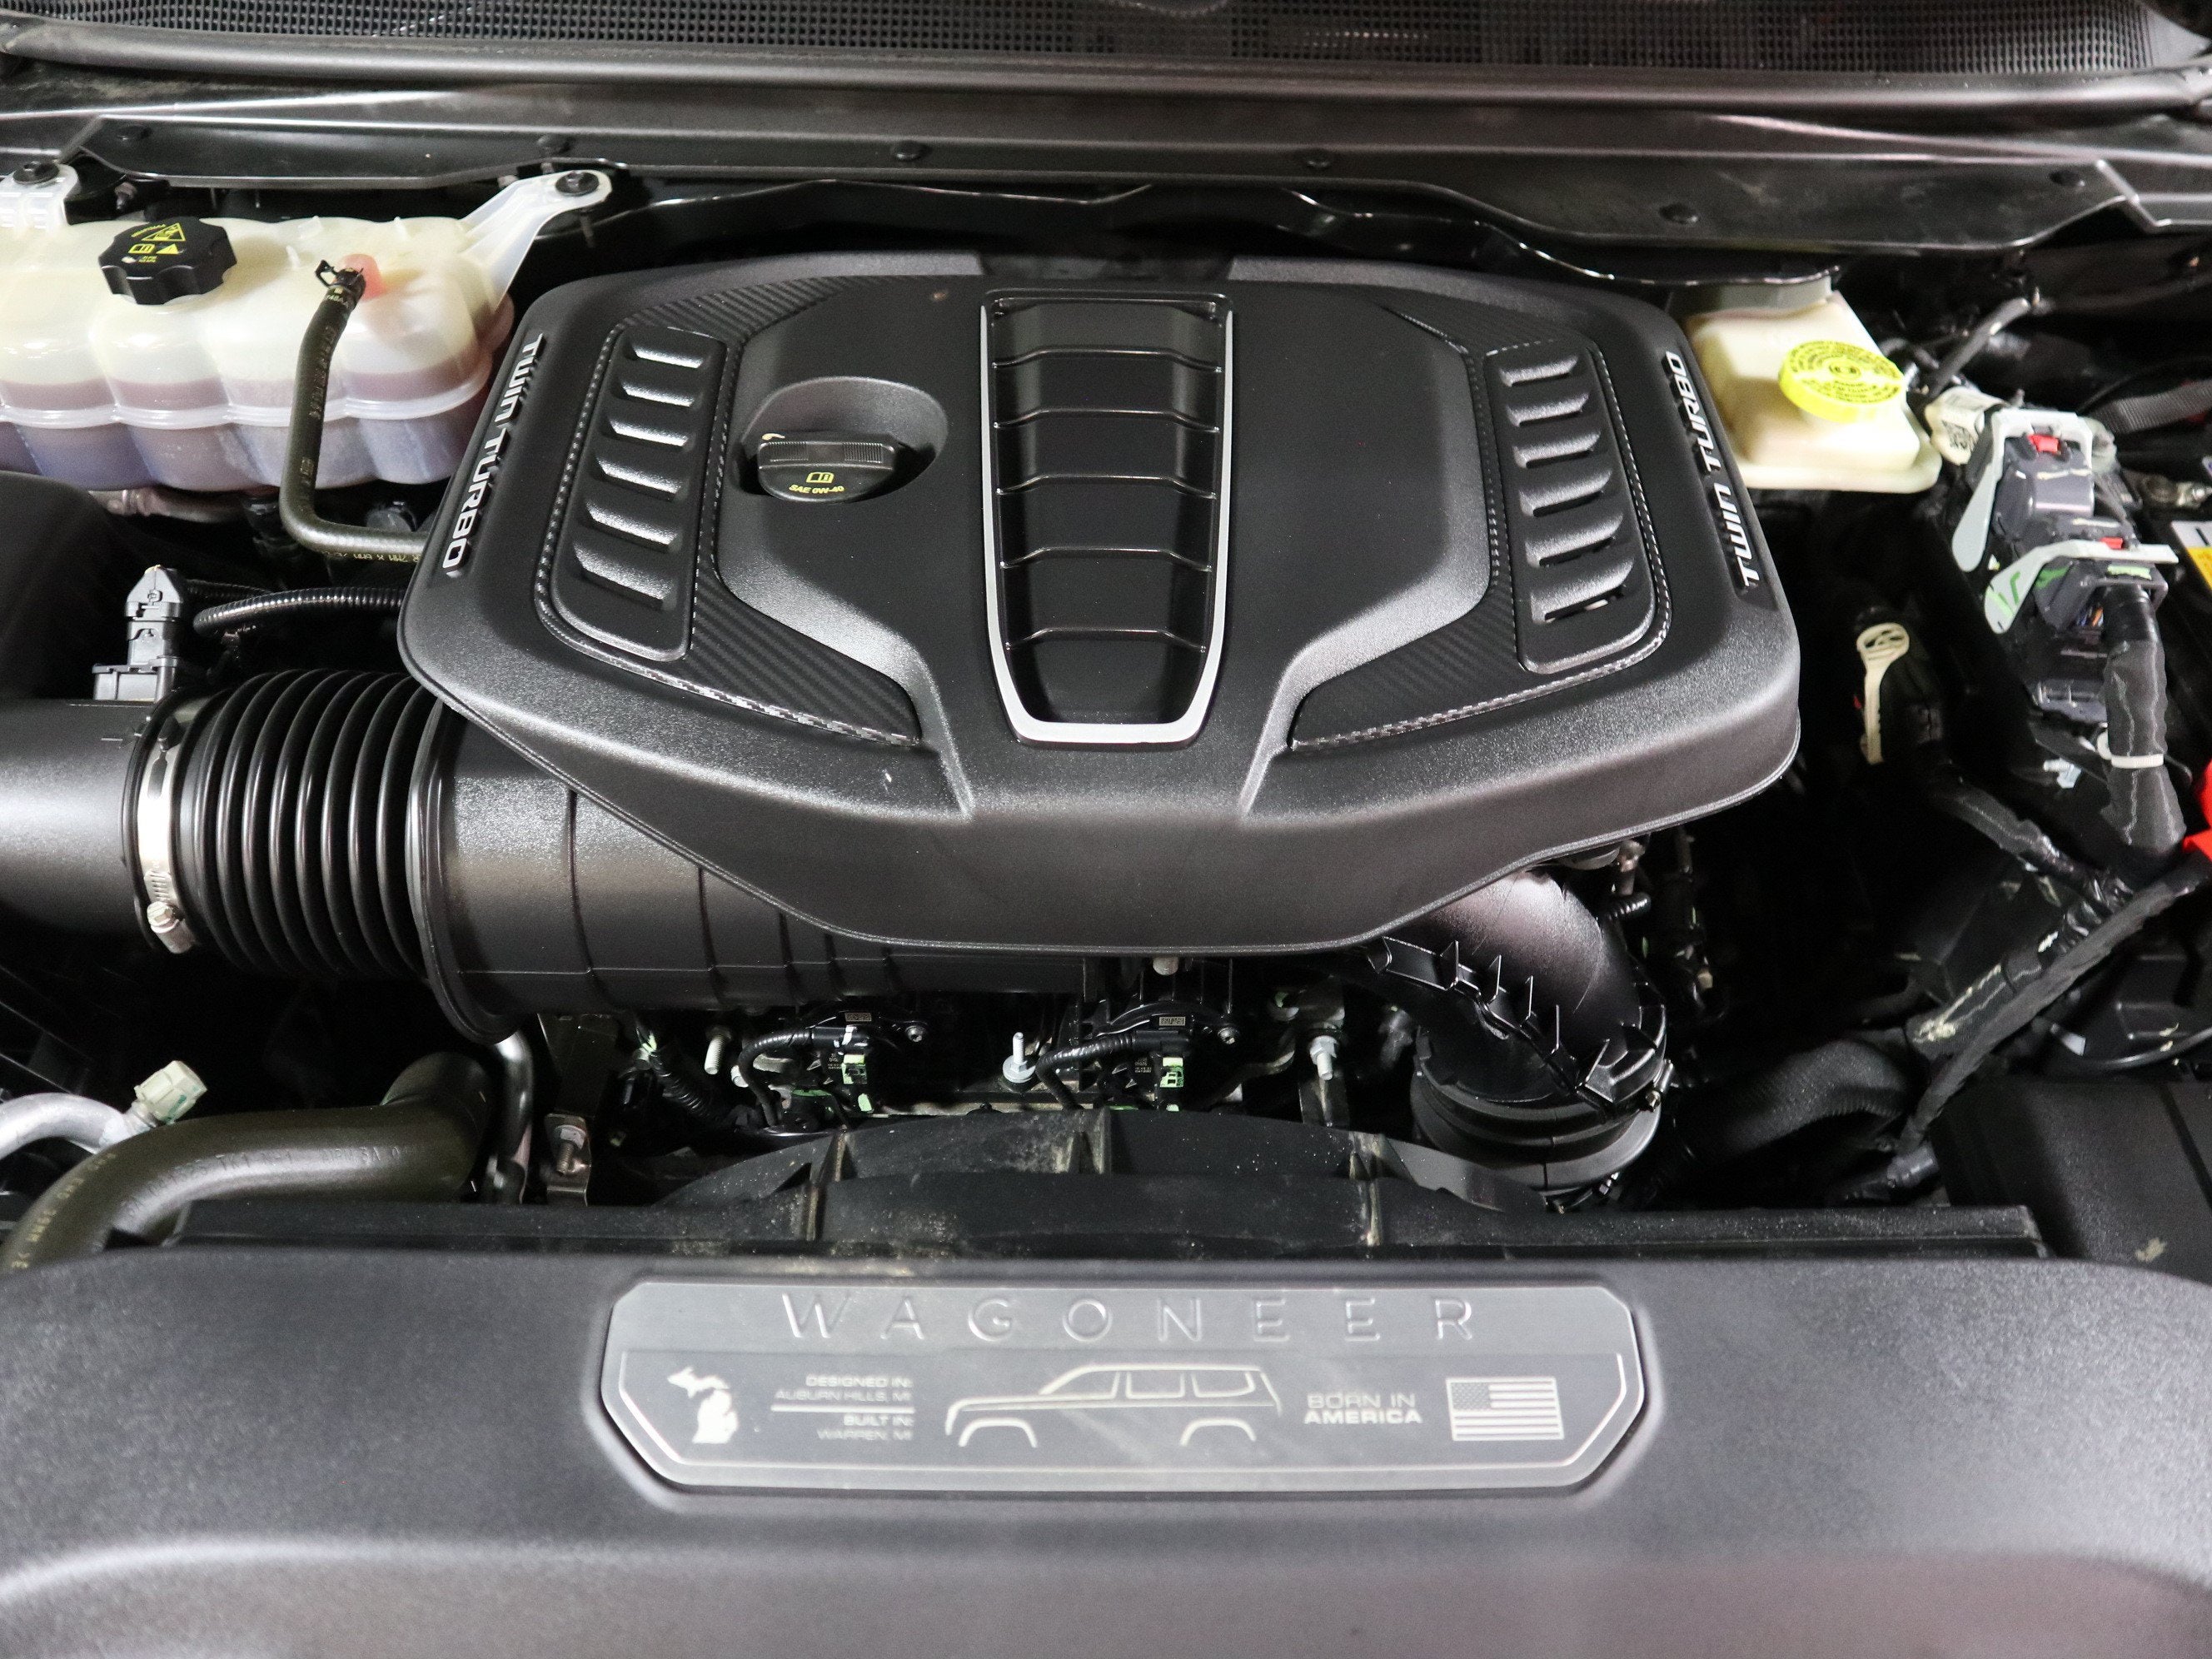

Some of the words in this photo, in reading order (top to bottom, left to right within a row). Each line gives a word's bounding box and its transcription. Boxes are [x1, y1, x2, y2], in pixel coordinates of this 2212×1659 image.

[494, 333, 543, 423] TWIN
[1665, 350, 1721, 473] TURBO
[788, 484, 812, 494] SAE
[441, 427, 507, 570] TURBO
[1713, 481, 1760, 587] TWIN
[781, 1292, 1474, 1343] WAGONEER
[805, 1374, 889, 1388] DESIGNED
[775, 1389, 841, 1402] AUBURN
[1307, 1392, 1381, 1409] BORN
[1390, 1392, 1416, 1408] IN
[843, 1414, 889, 1427] BUILT
[1303, 1408, 1423, 1425] AMERICA
